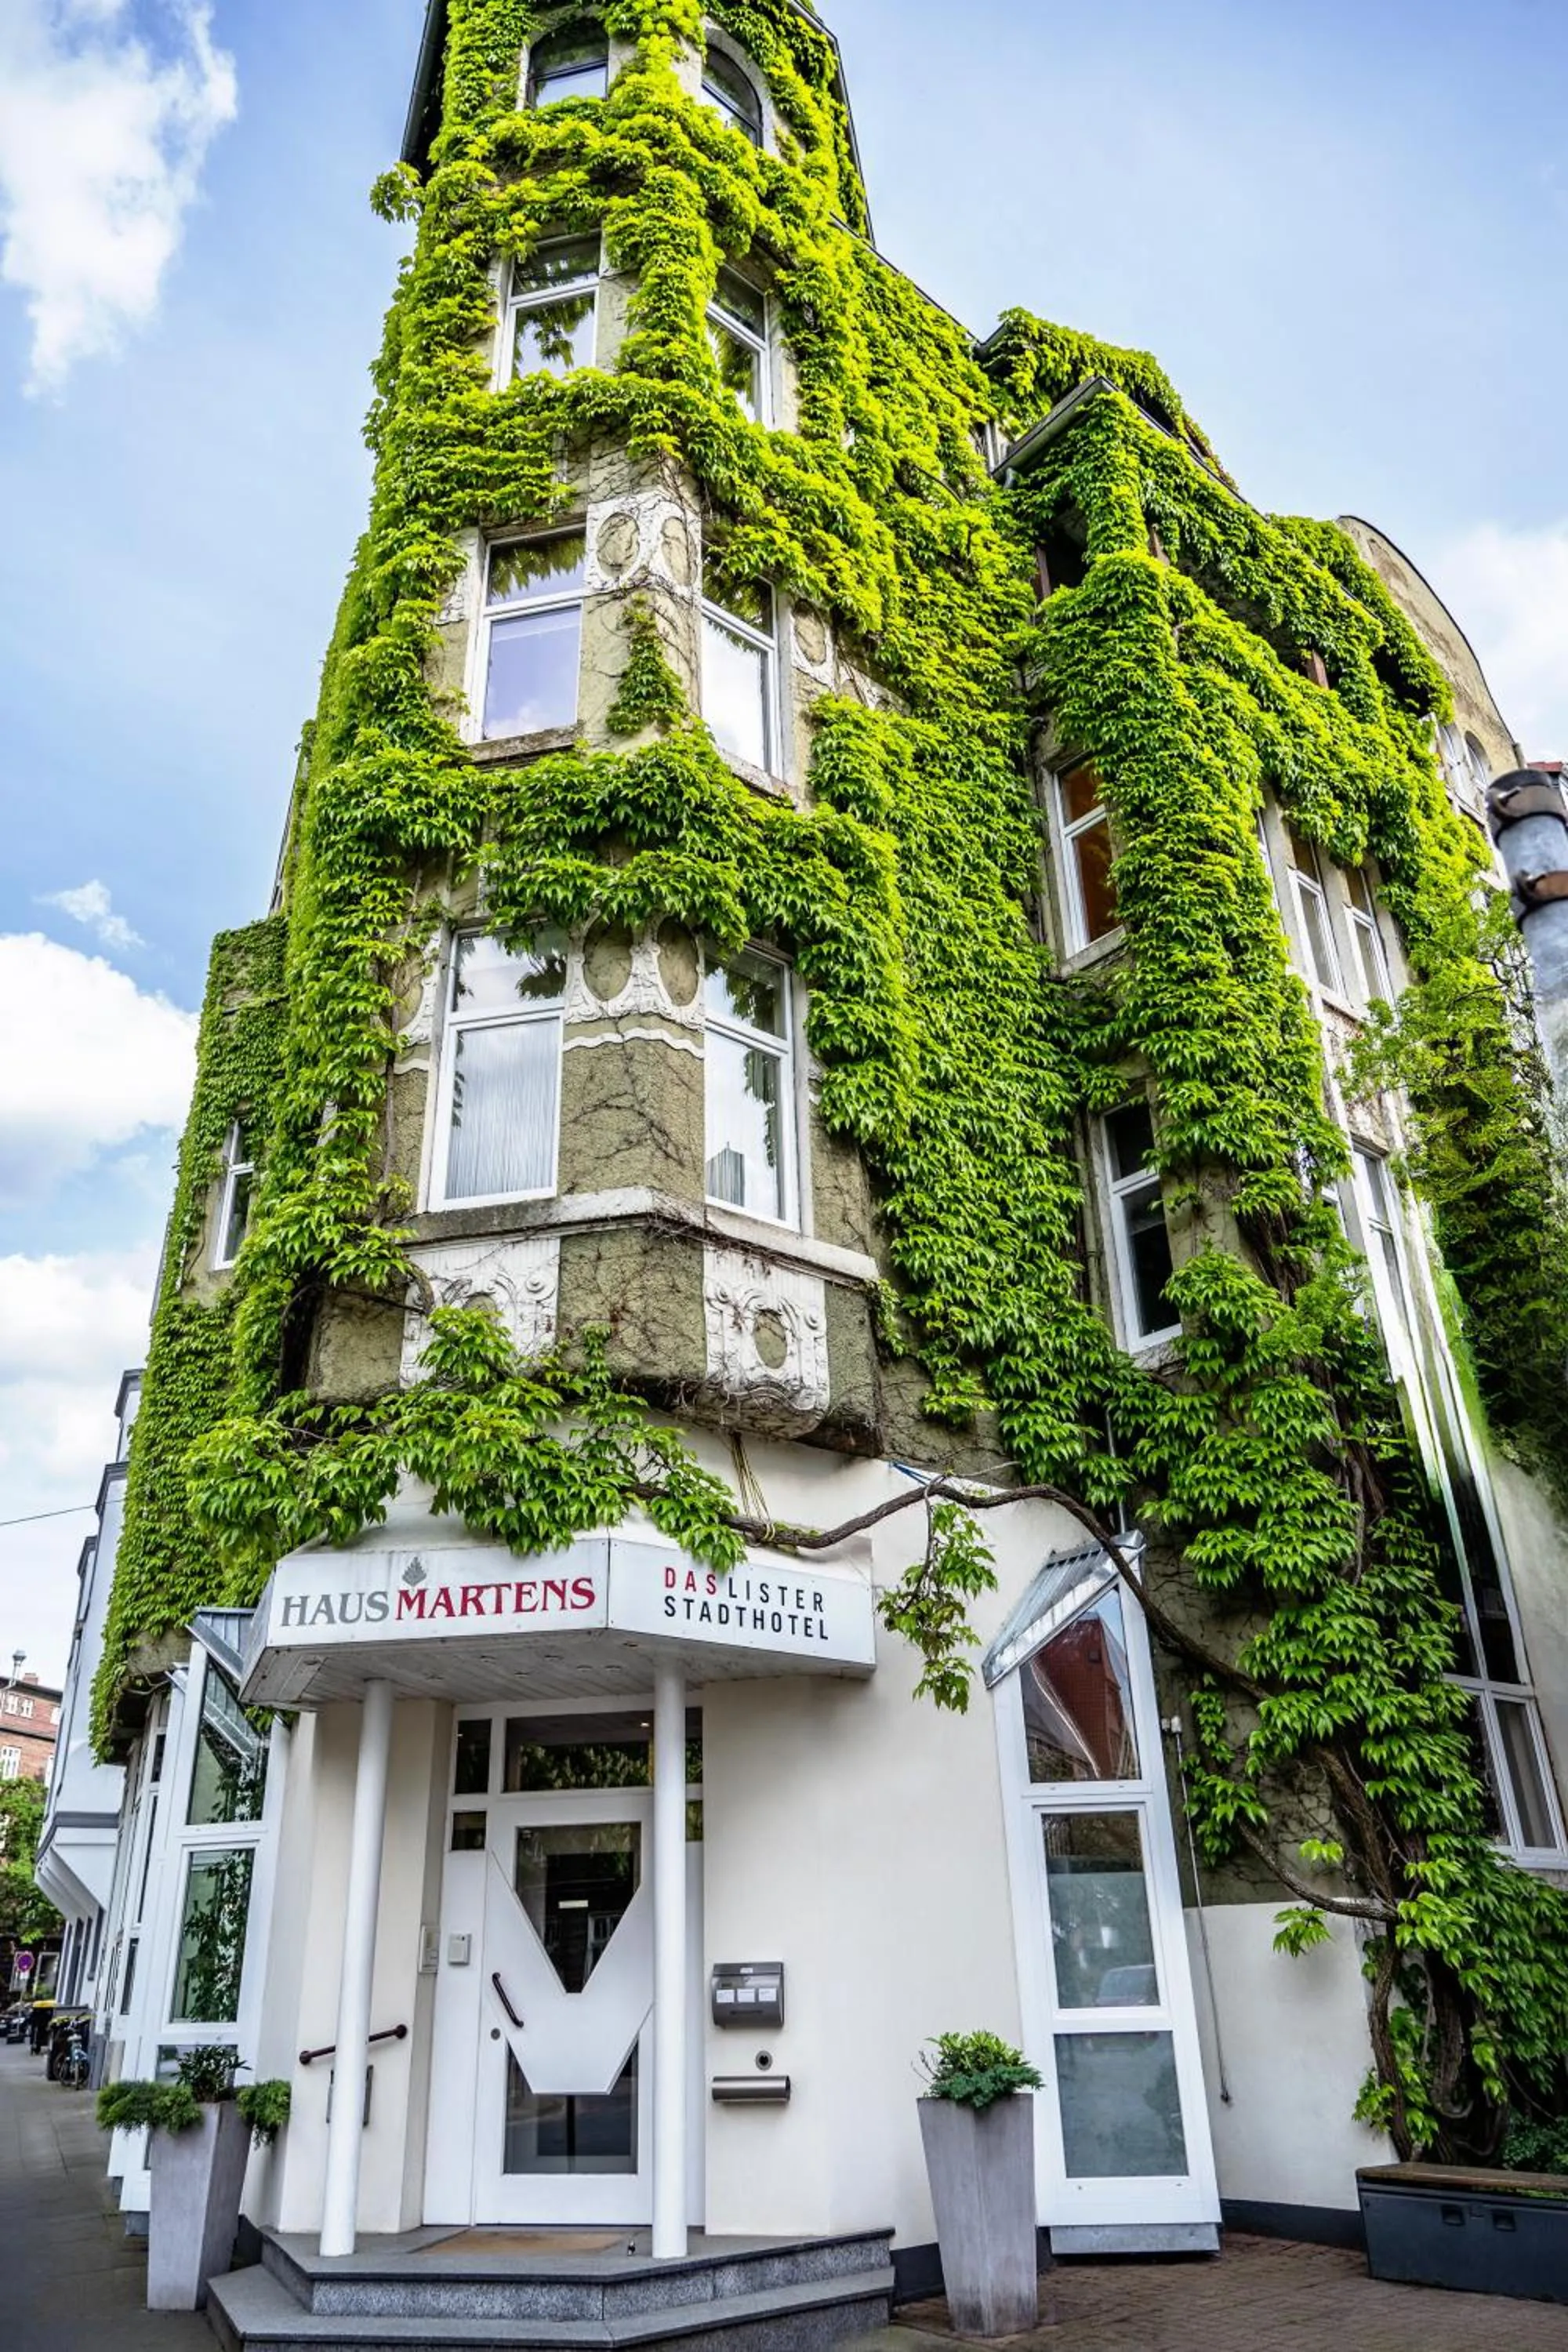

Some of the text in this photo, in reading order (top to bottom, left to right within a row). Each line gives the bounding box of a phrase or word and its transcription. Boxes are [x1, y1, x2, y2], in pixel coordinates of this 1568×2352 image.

[281, 1577, 596, 1627] HAUS MARTENS
[665, 1566, 824, 1613] DAS LISTER
[664, 1595, 829, 1640] STADTHOTEL
